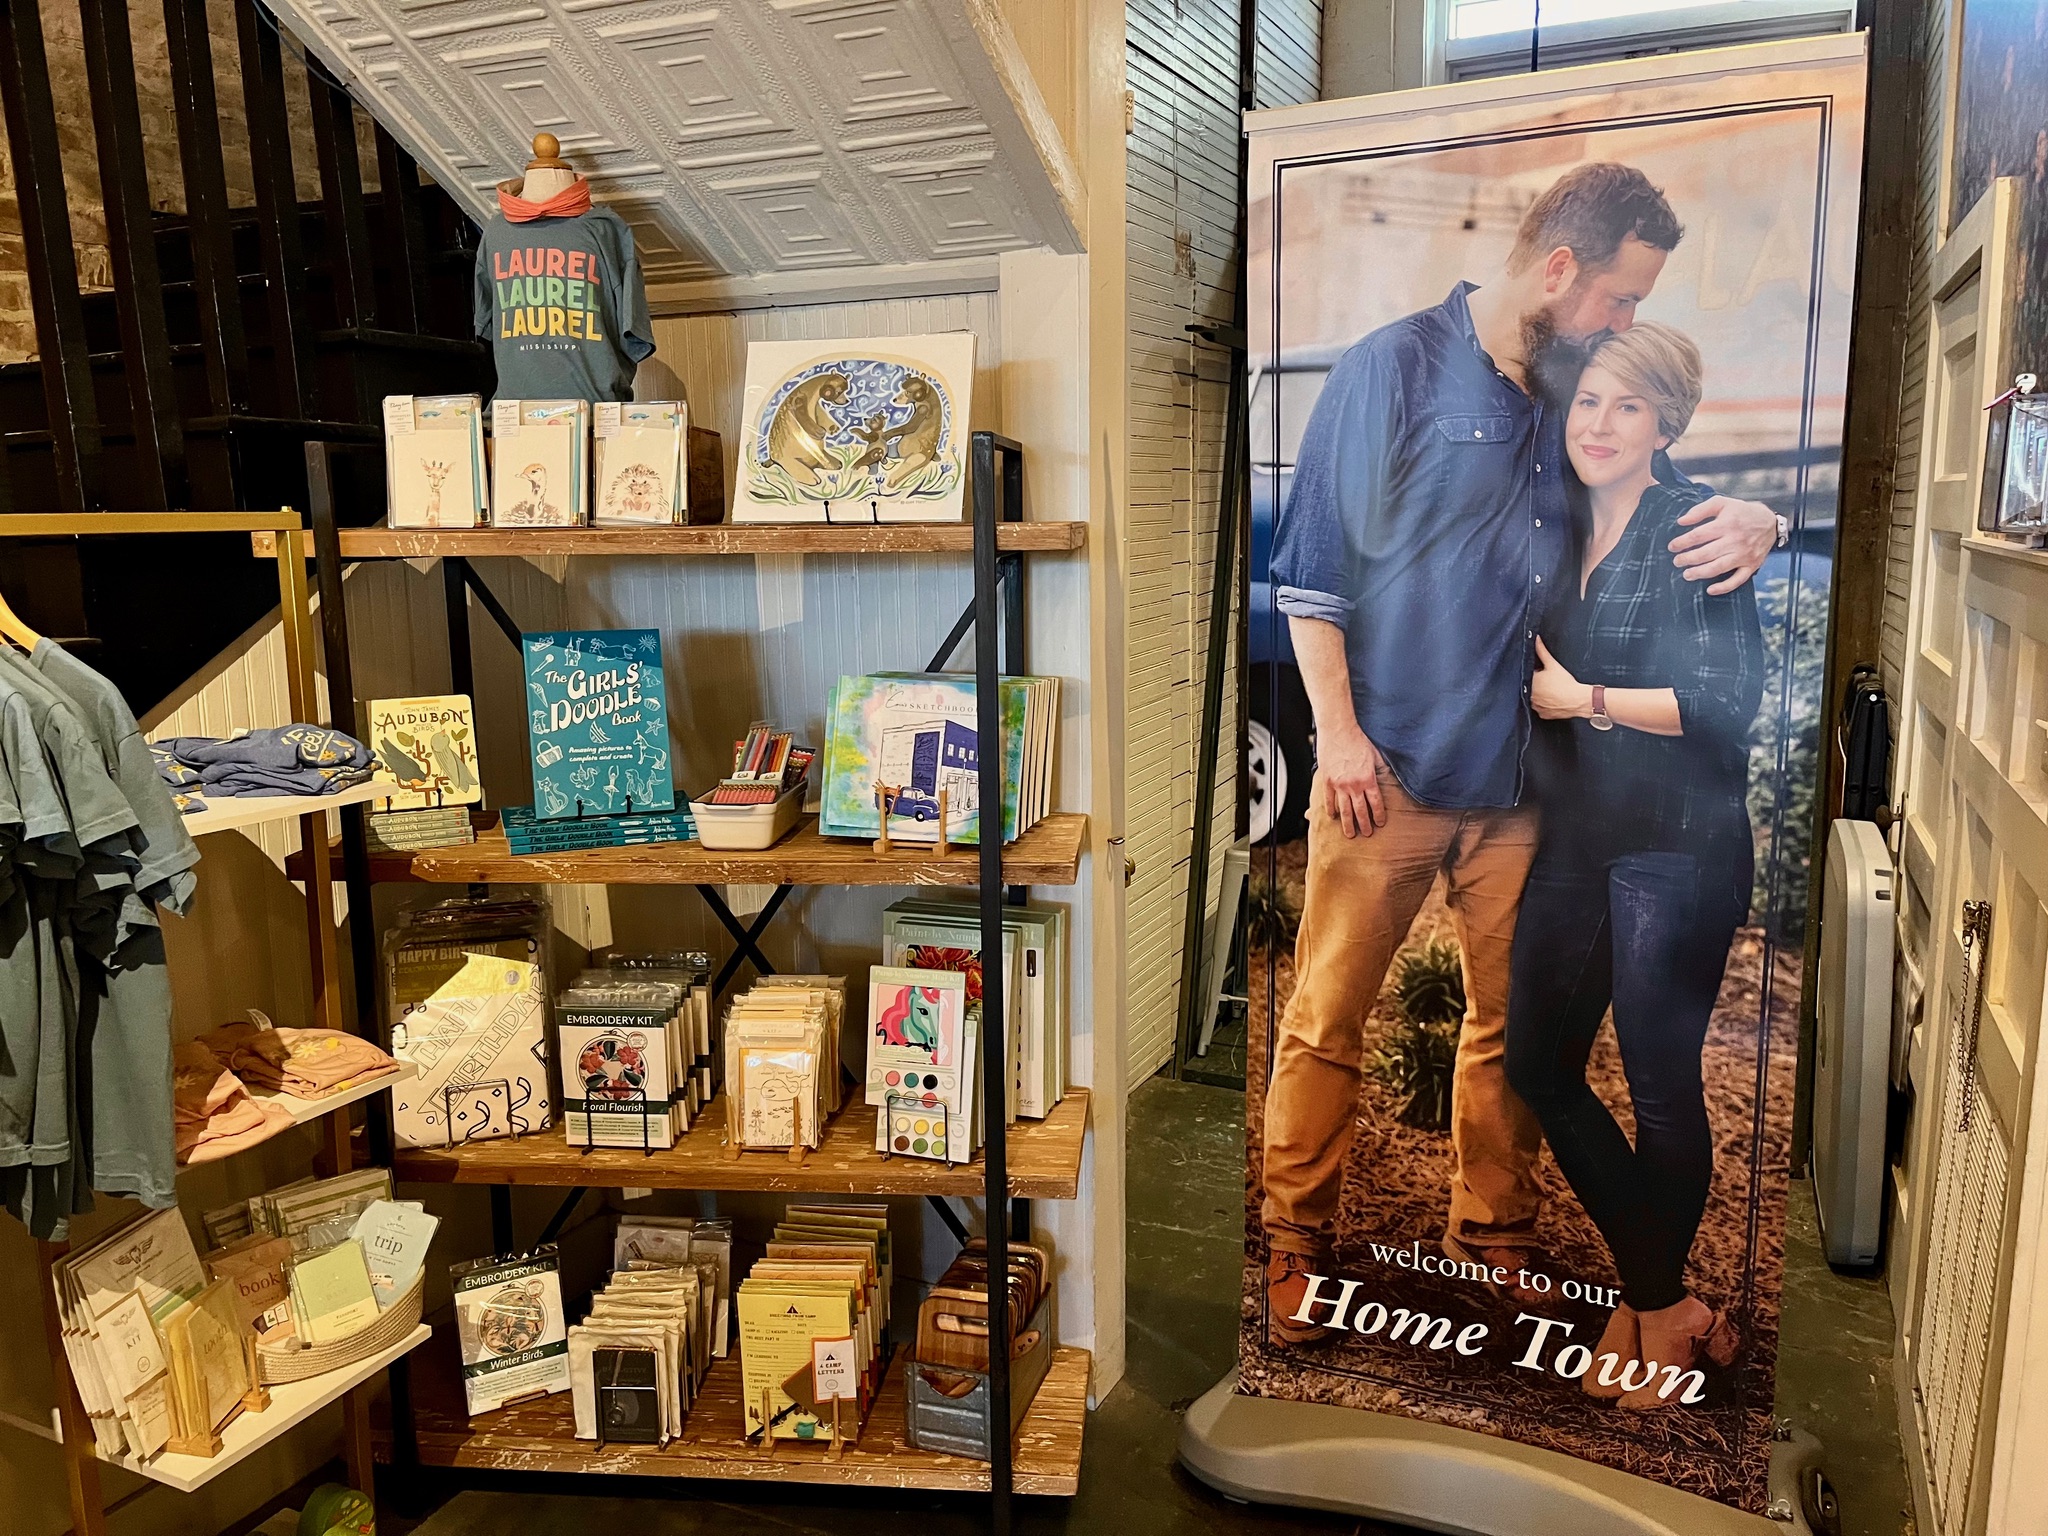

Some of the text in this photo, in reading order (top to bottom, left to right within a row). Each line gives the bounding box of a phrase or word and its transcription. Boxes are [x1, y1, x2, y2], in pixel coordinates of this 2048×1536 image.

[494, 247, 601, 286] LAUREL
[496, 276, 601, 313] LAUREL
[500, 306, 603, 342] LAUREL
[544, 660, 644, 700] The GIRLS'
[550, 683, 643, 732] DOODLE
[909, 702, 978, 713] SKETCHBOO
[374, 708, 468, 734] AUDUBON
[612, 710, 642, 726] Book
[568, 746, 597, 755] Amazing
[598, 745, 625, 755] pictures
[569, 753, 634, 763] complete and create
[387, 824, 418, 833] AUDUBON
[388, 816, 418, 825] AUDUBON
[563, 823, 590, 831] DOODLE
[591, 821, 609, 829] BOOK
[391, 832, 421, 841] AUDUBON
[595, 830, 613, 838] BOOK
[394, 841, 423, 850] AUDUBON
[569, 841, 595, 849] DOODLE
[596, 839, 614, 847] BOOK
[399, 948, 437, 964] HAPPY
[566, 1014, 654, 1025] EMBROIDERY KIT
[582, 1101, 644, 1112] Foral Flourish
[374, 1233, 404, 1256] trip
[465, 1262, 548, 1289] EMBROIDERY KIT
[1368, 1239, 1622, 1310] welcome to our
[238, 1271, 281, 1298] book
[1287, 1271, 1707, 1406] Home Town
[489, 1349, 544, 1370] Winter Birds
